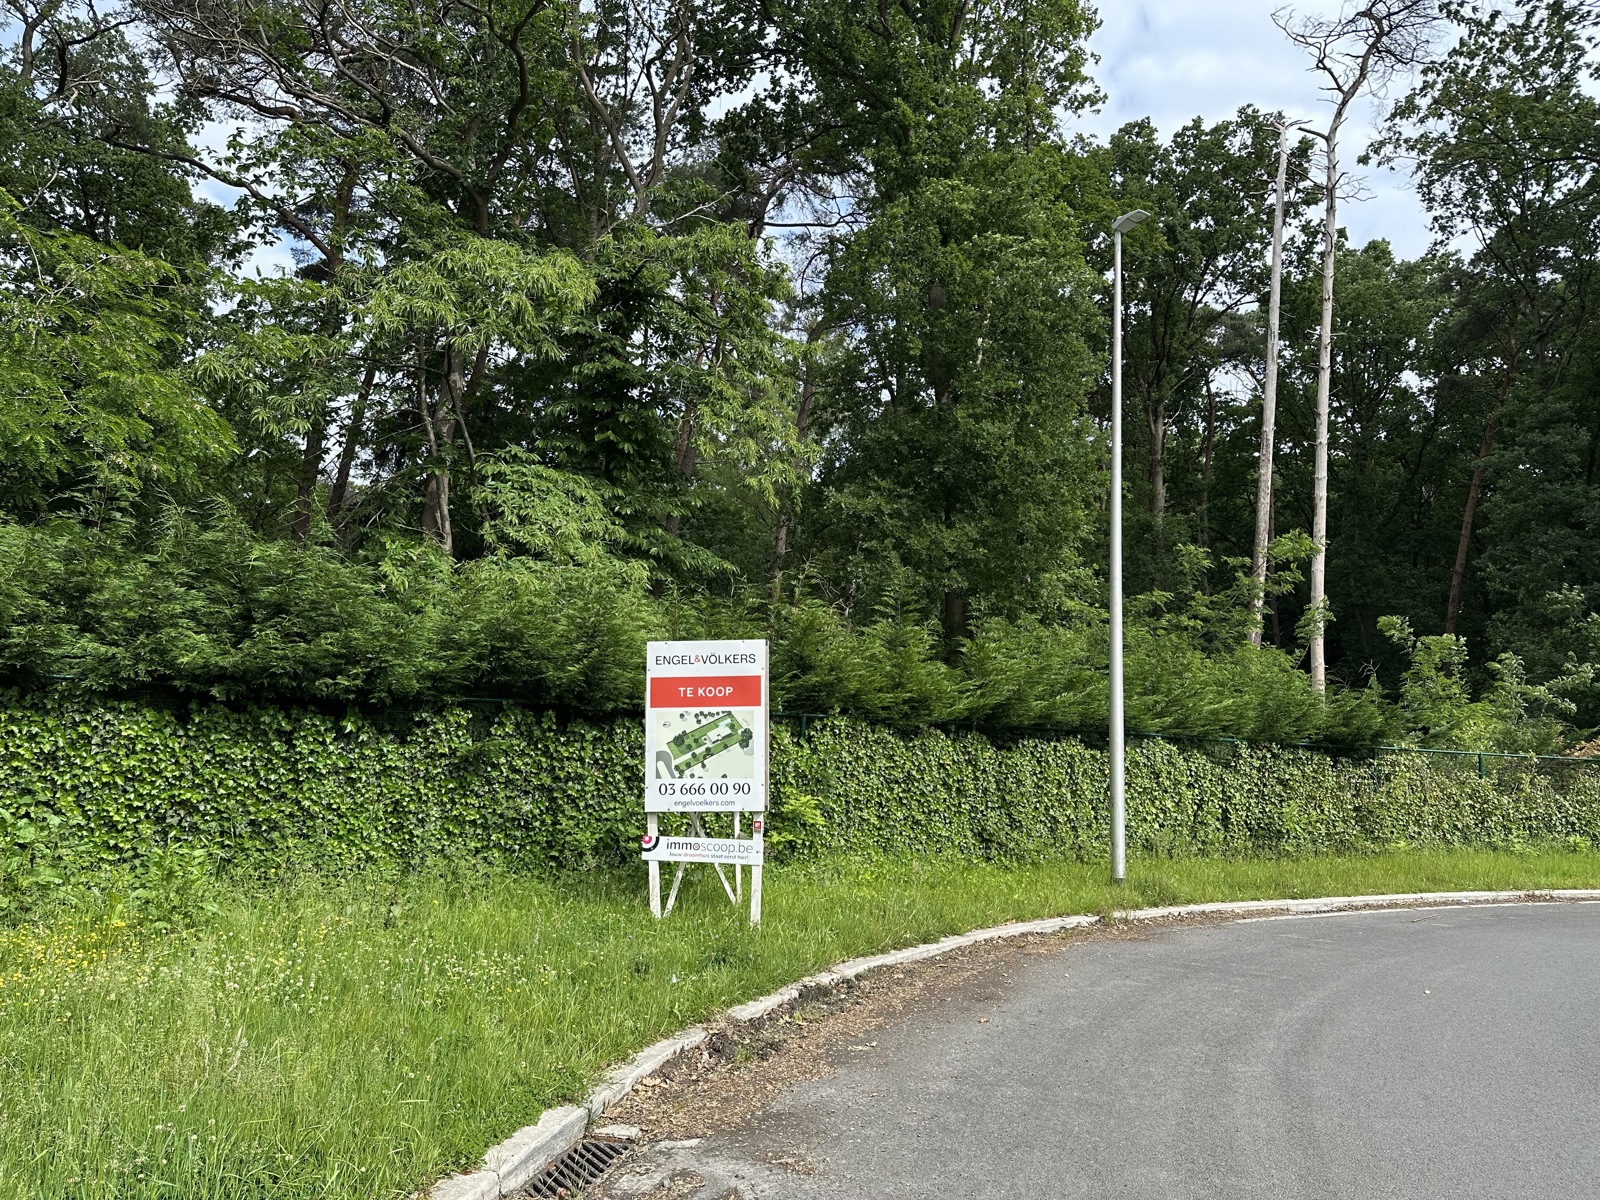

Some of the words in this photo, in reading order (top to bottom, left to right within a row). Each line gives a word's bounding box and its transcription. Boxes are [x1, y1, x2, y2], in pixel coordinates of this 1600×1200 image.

[655, 653, 756, 665] ENGEL&VÖLKERS
[678, 687, 694, 697] TE
[698, 686, 734, 697] KOOP
[658, 783, 676, 795] 03
[680, 782, 706, 795] 666
[710, 782, 729, 795] 00
[733, 782, 751, 795] 90
[674, 799, 735, 808] engelvoelkers.com
[666, 839, 753, 853] immoscoop.be
